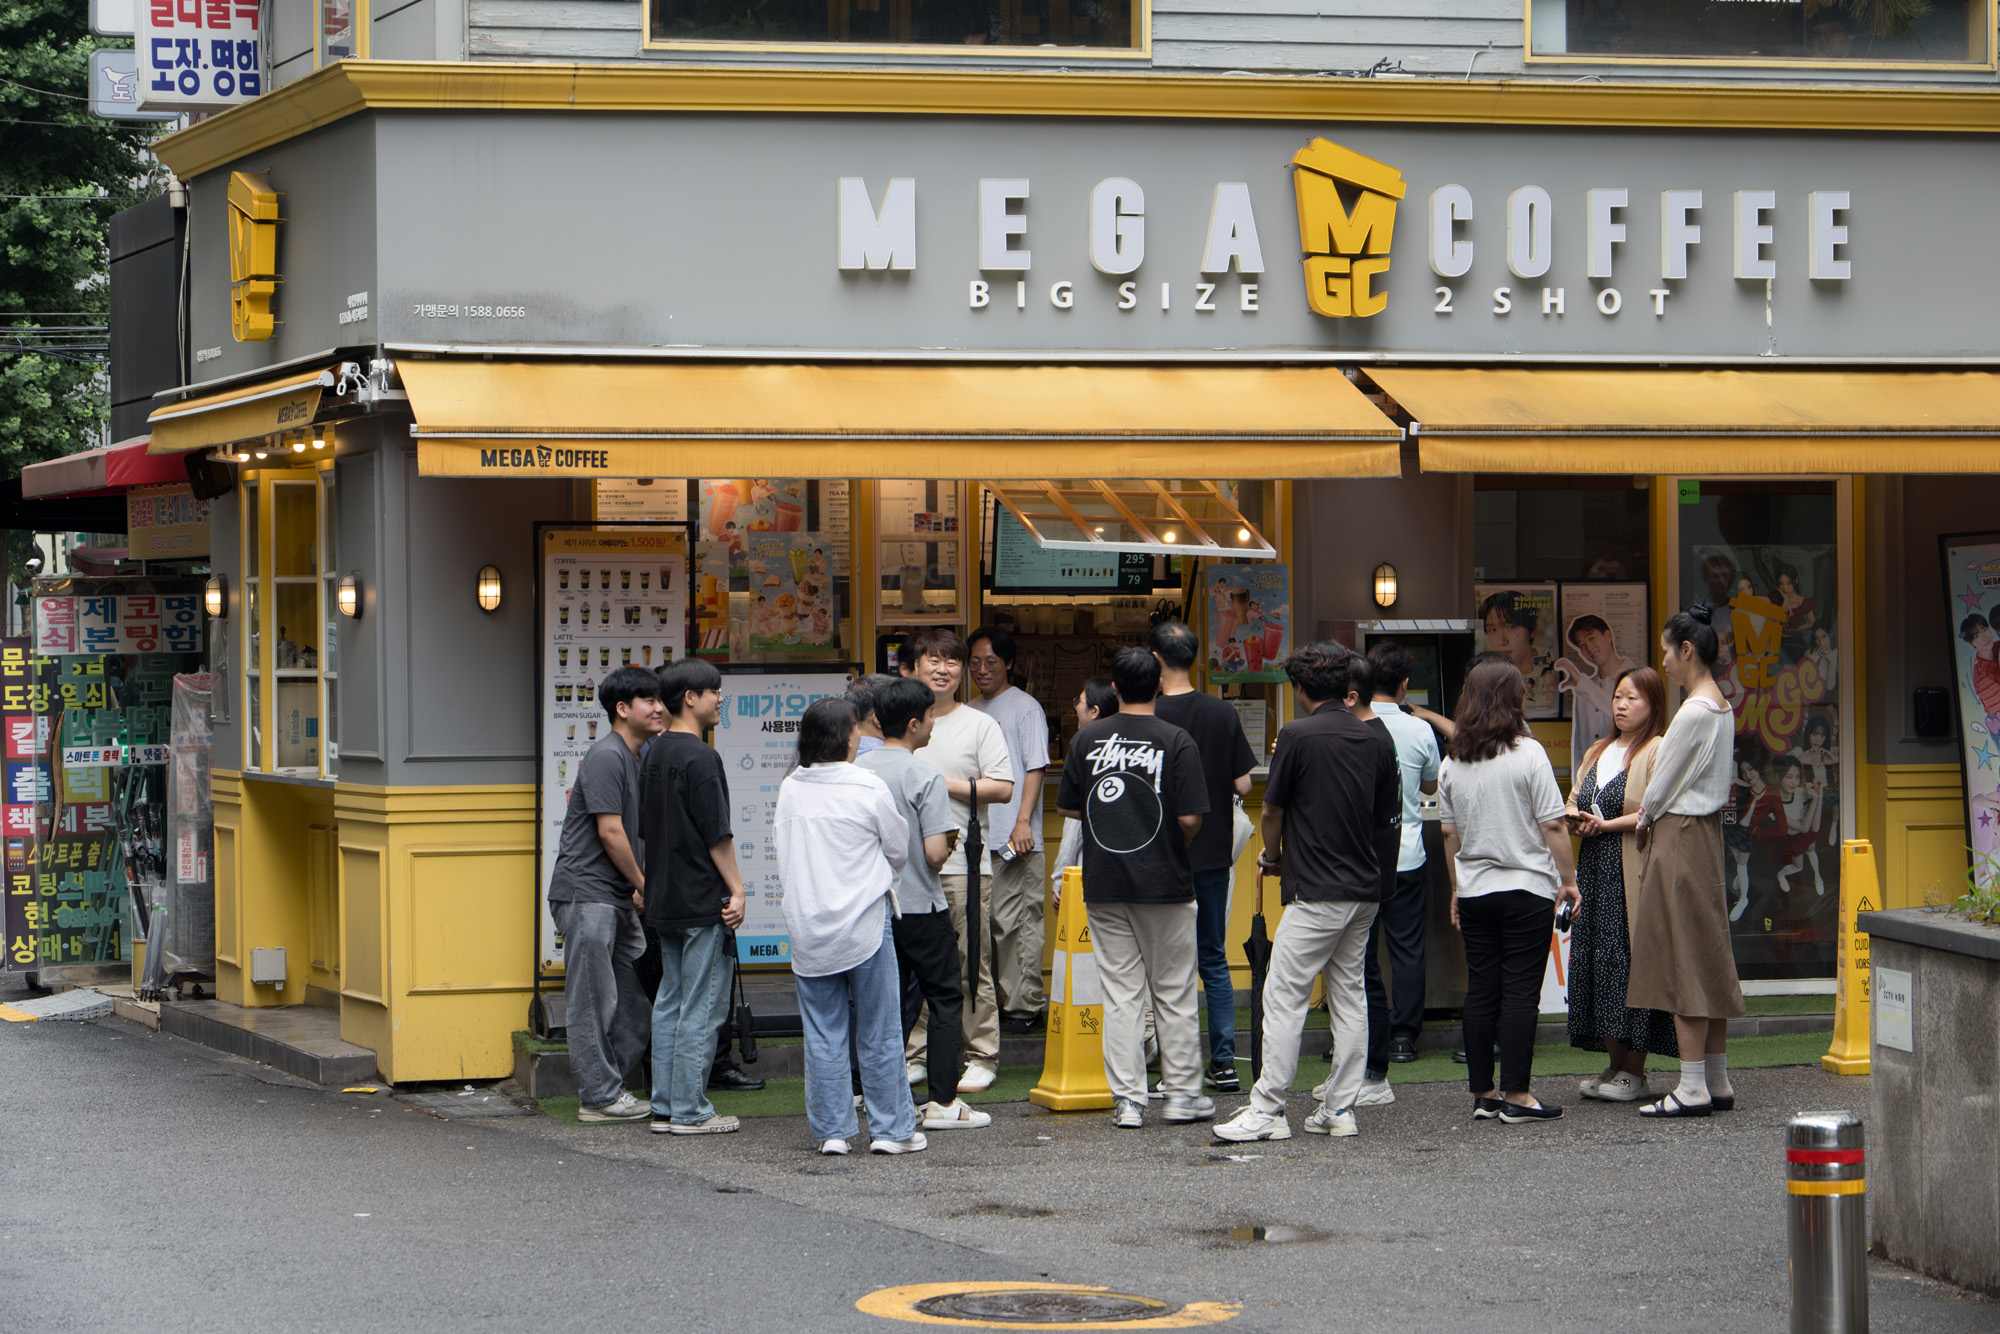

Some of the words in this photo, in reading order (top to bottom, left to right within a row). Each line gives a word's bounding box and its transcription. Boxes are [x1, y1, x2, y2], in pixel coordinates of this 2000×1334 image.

[837, 176, 1265, 275] MEGA
[1428, 183, 1851, 281] COFFEE
[969, 280, 1074, 310] BIG
[1117, 281, 1259, 312] SIZE
[413, 304, 460, 320] 가맹문의
[462, 305, 526, 320] 1588.0656
[481, 449, 536, 467] MEGA
[555, 449, 608, 468] COFFEE
[1126, 554, 1146, 565] 295
[1128, 574, 1142, 585] 79
[41, 597, 76, 654] 열쇠
[82, 596, 120, 653] 제본
[123, 596, 160, 653] 코팅
[162, 596, 202, 653] 명함
[737, 694, 829, 718] 메가오
[554, 712, 579, 720] BROWN
[580, 712, 602, 720] SUGAR
[66, 751, 100, 763] 스마트폰
[103, 749, 119, 762] 출력
[554, 750, 573, 758] MOJITO
[750, 945, 779, 958] MEGA
[1855, 938, 1869, 951] CUID
[1855, 958, 1870, 970] VORS
